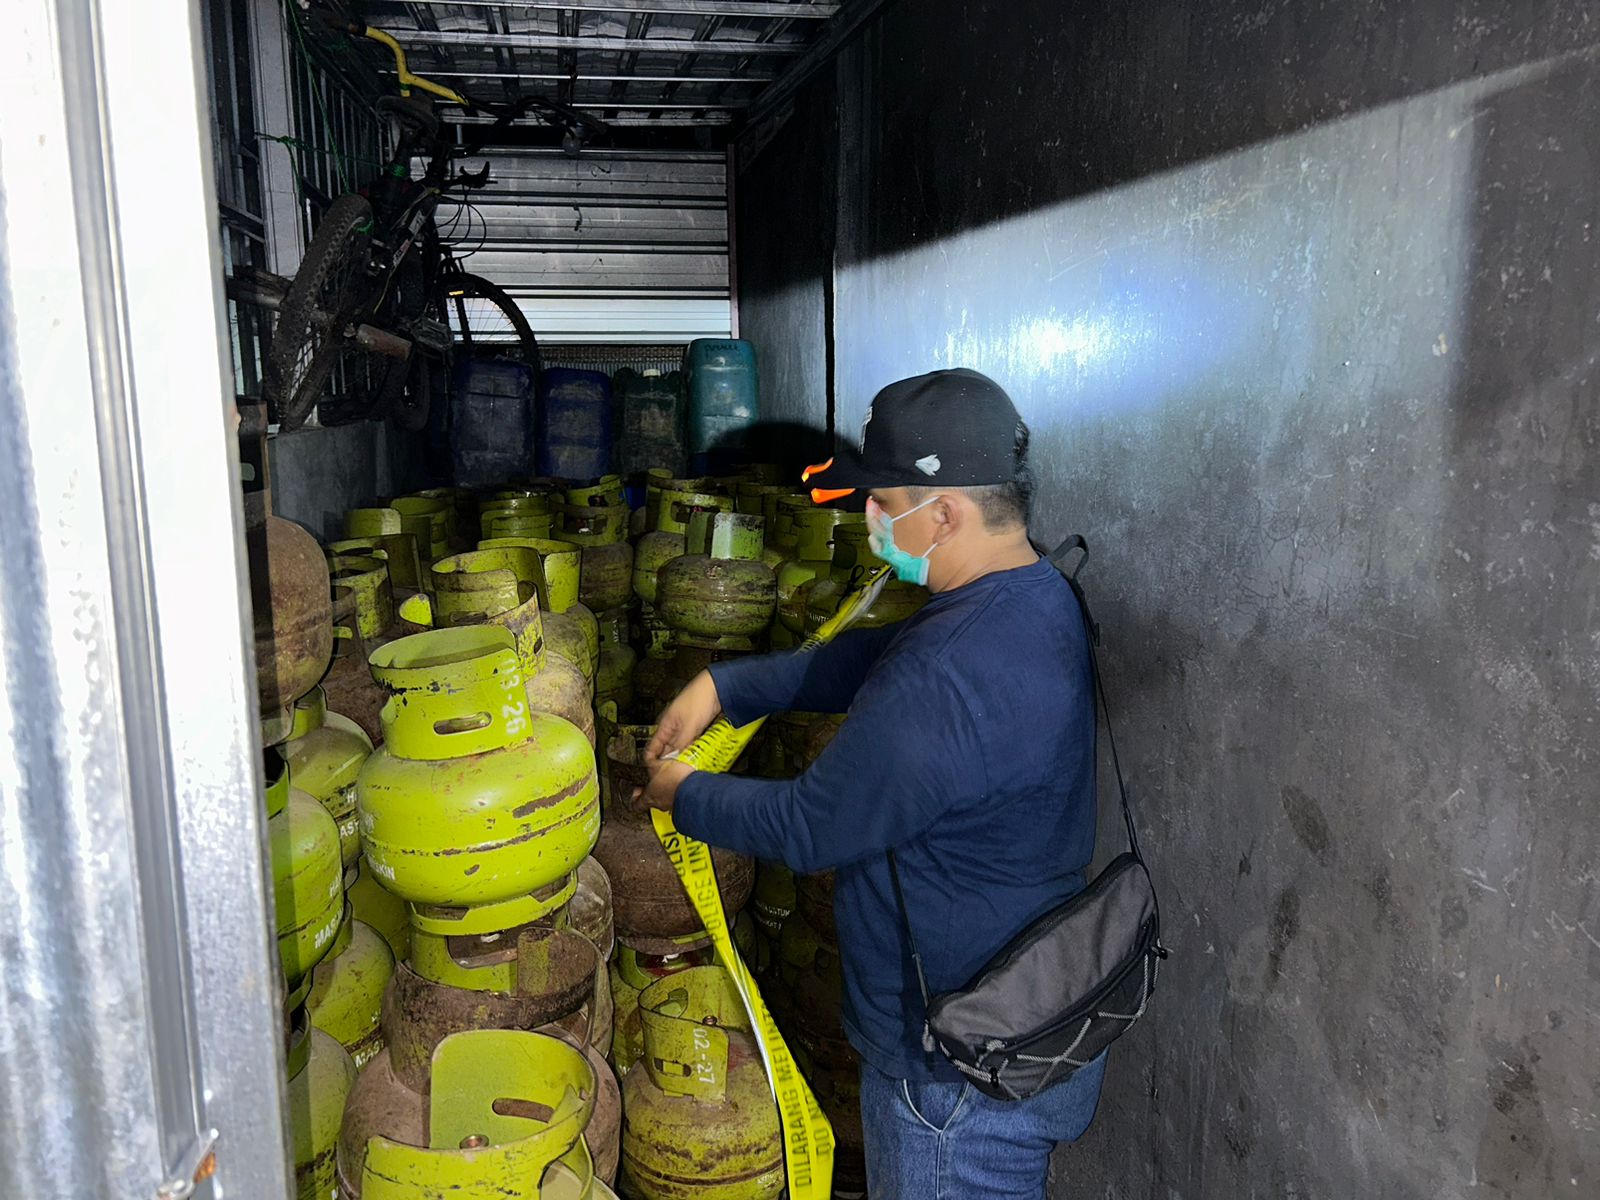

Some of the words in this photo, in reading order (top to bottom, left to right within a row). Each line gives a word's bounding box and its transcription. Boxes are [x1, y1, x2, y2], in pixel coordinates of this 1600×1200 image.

[696, 878, 724, 941] POLICE
[693, 1028, 715, 1084] 02-27
[782, 1089, 812, 1188] DILARANG
